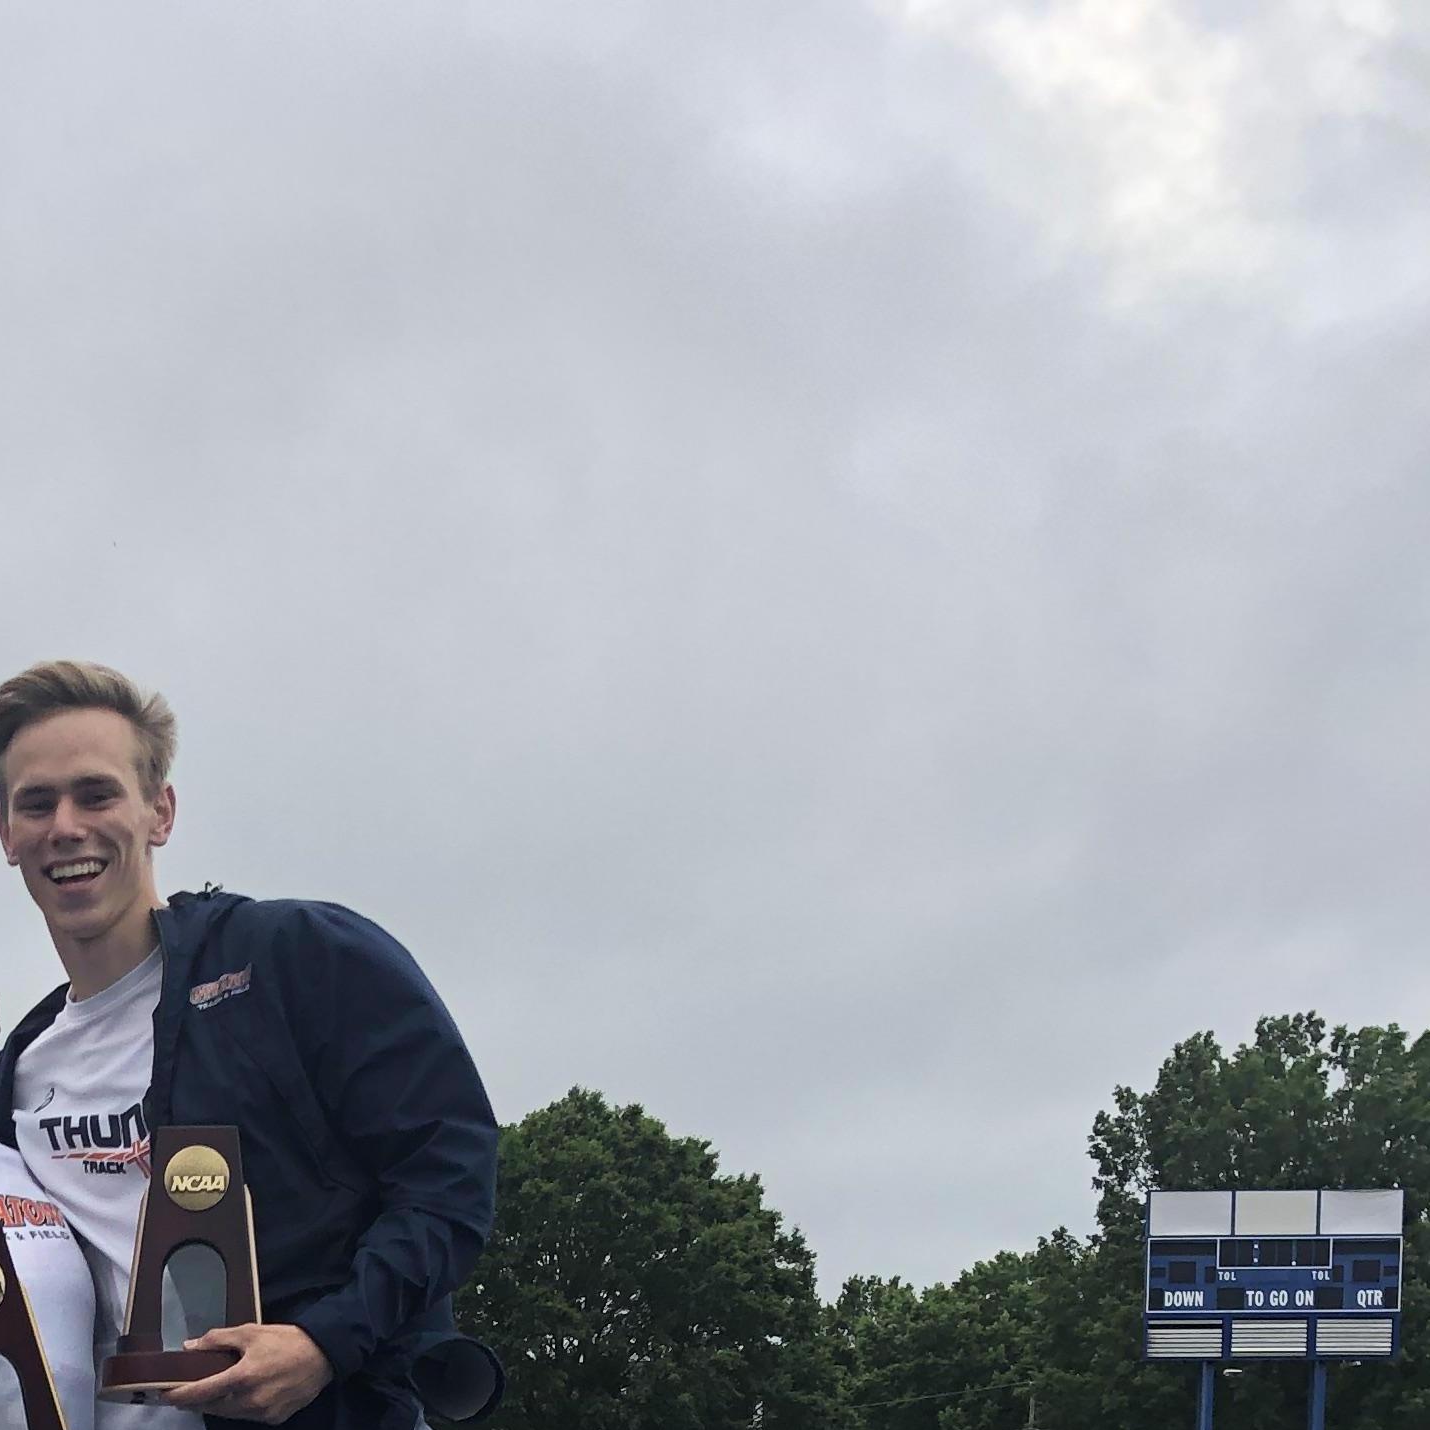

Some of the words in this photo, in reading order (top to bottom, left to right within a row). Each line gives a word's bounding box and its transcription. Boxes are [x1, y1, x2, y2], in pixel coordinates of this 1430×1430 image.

[83, 1160, 127, 1174] TRACK
[170, 1175, 226, 1193] NCAA
[30, 1230, 71, 1241] FIELD
[1218, 1271, 1236, 1281] TOL
[1312, 1270, 1330, 1280] TOL
[1164, 1291, 1204, 1307] DOWN
[1246, 1290, 1264, 1307] TO
[1269, 1290, 1288, 1307] GO
[1295, 1290, 1314, 1306] ON
[1356, 1290, 1383, 1307] QTR
